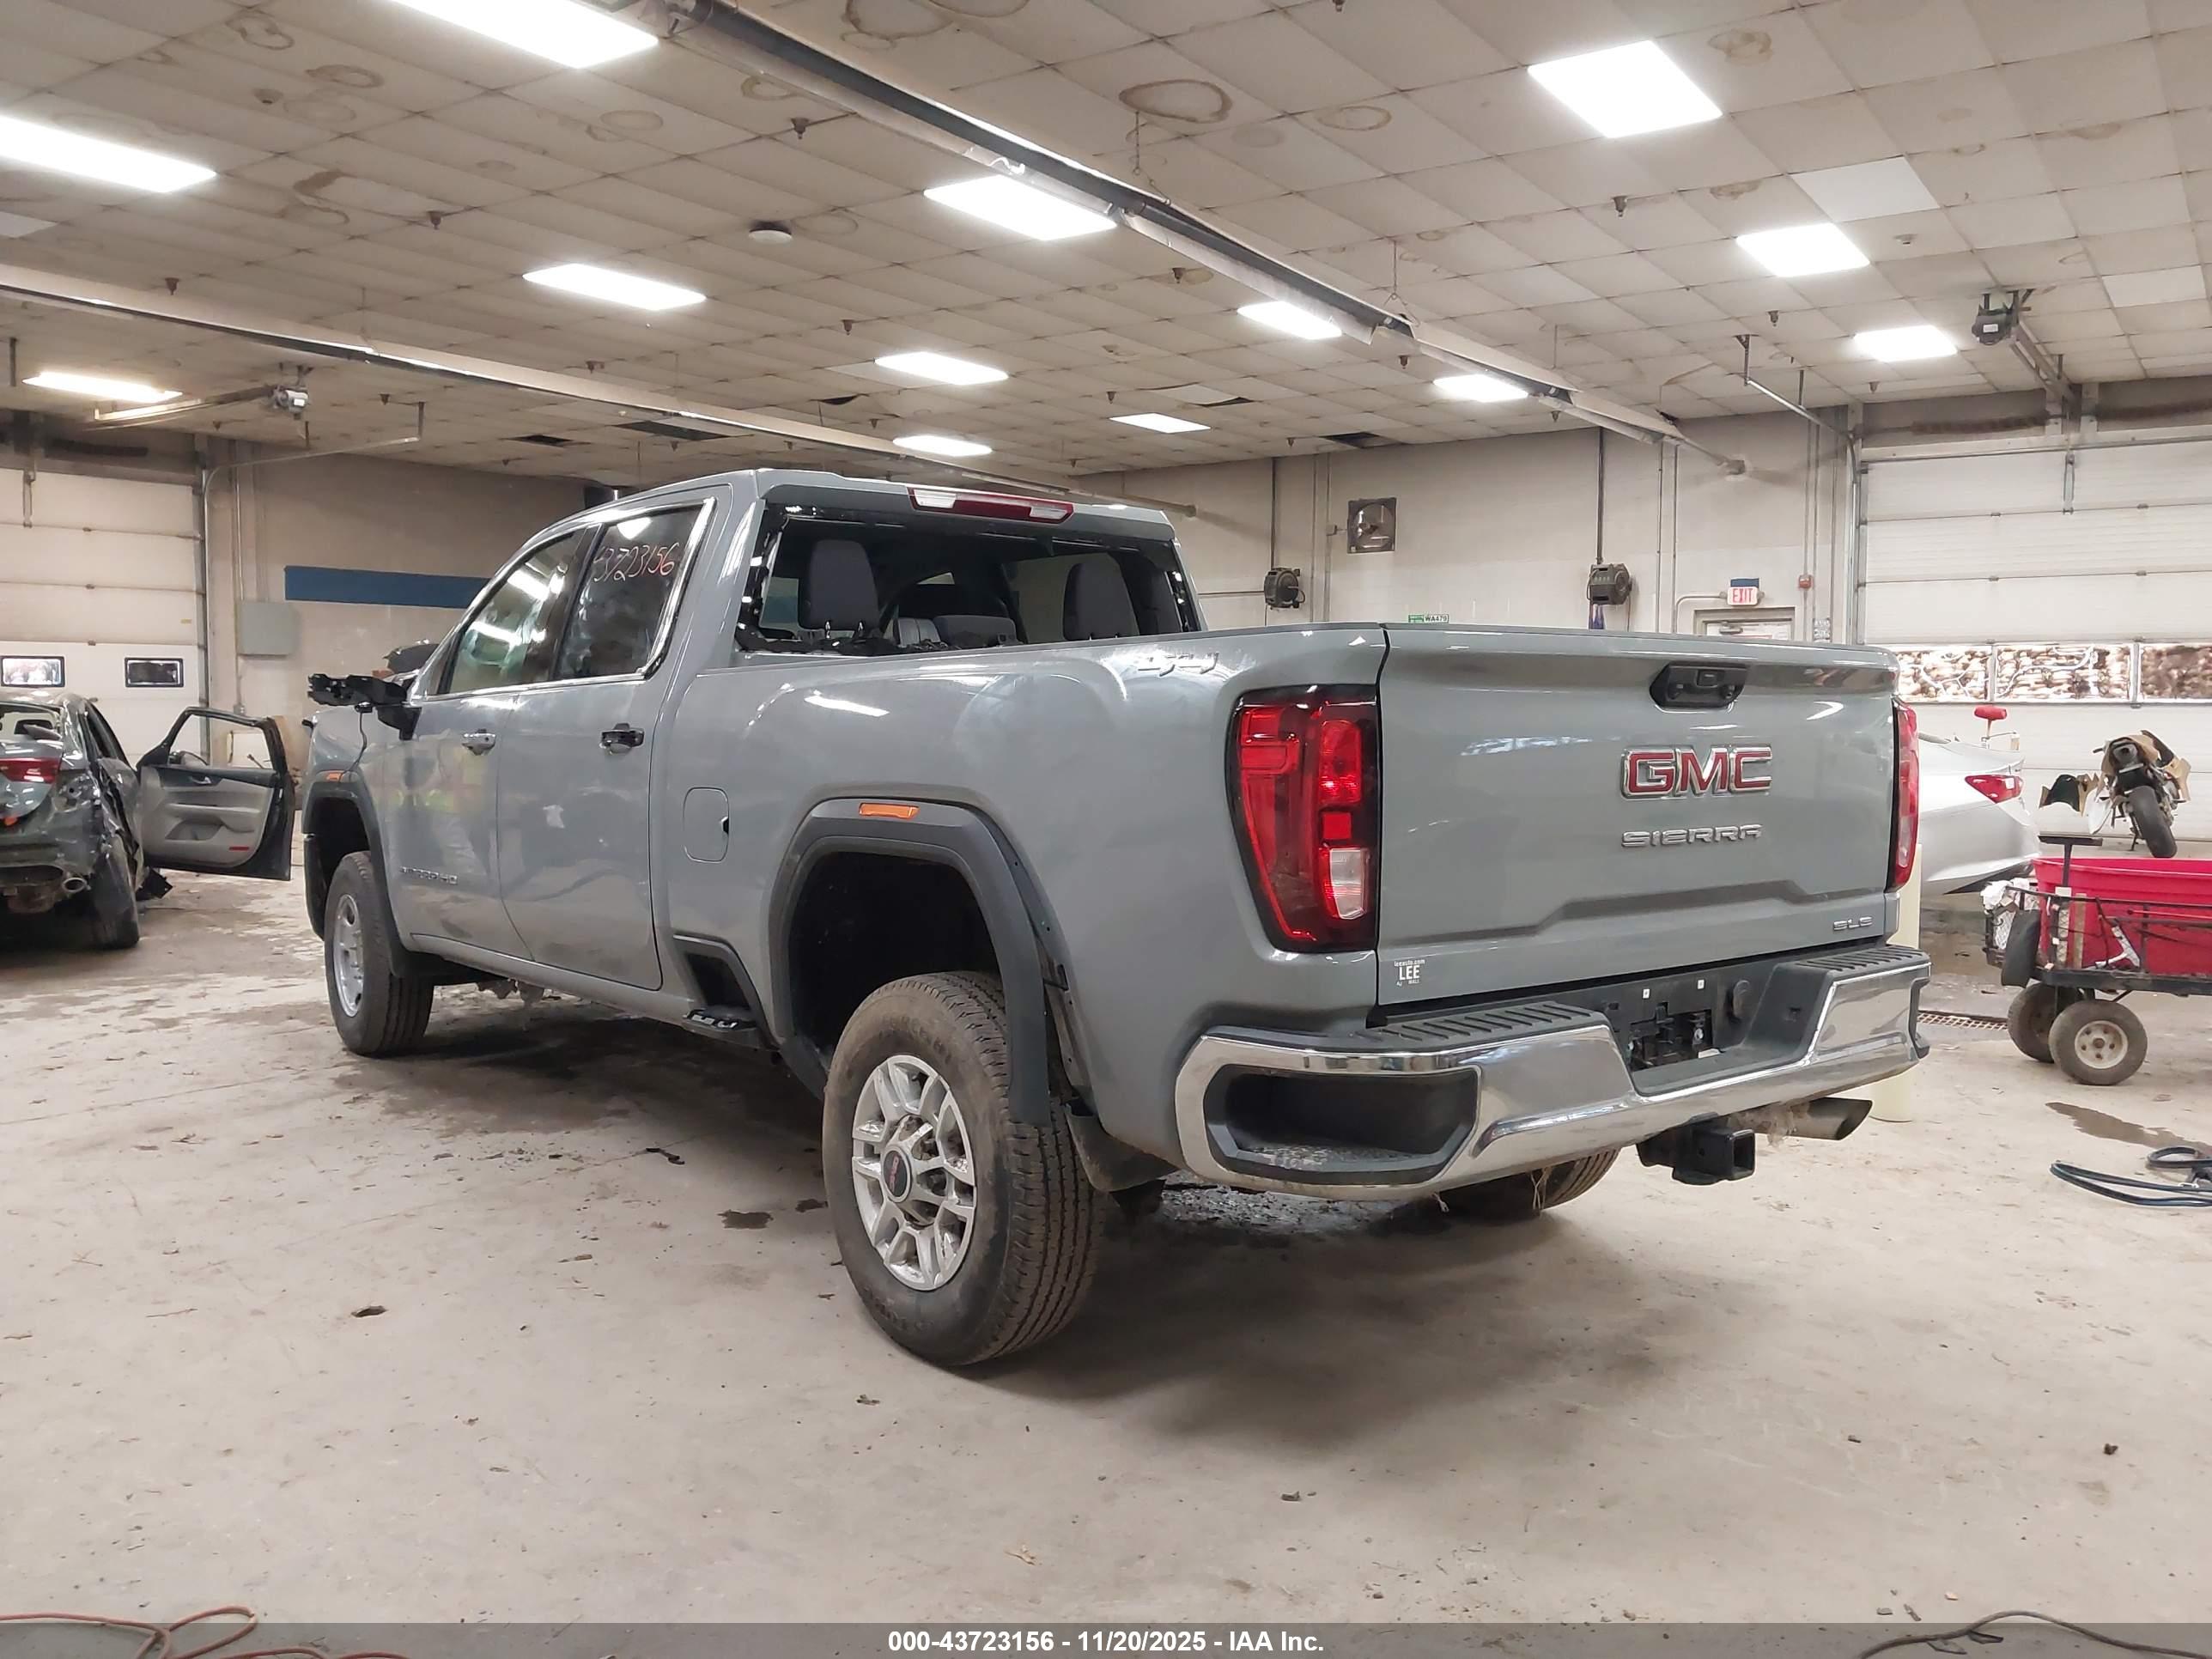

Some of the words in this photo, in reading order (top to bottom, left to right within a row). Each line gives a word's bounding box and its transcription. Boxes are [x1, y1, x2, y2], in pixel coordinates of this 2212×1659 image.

[1732, 588, 1753, 603] EXIT
[1622, 744, 1773, 799] GMC
[1621, 823, 1763, 848] SIERRA
[1399, 965, 1420, 981] LEE
